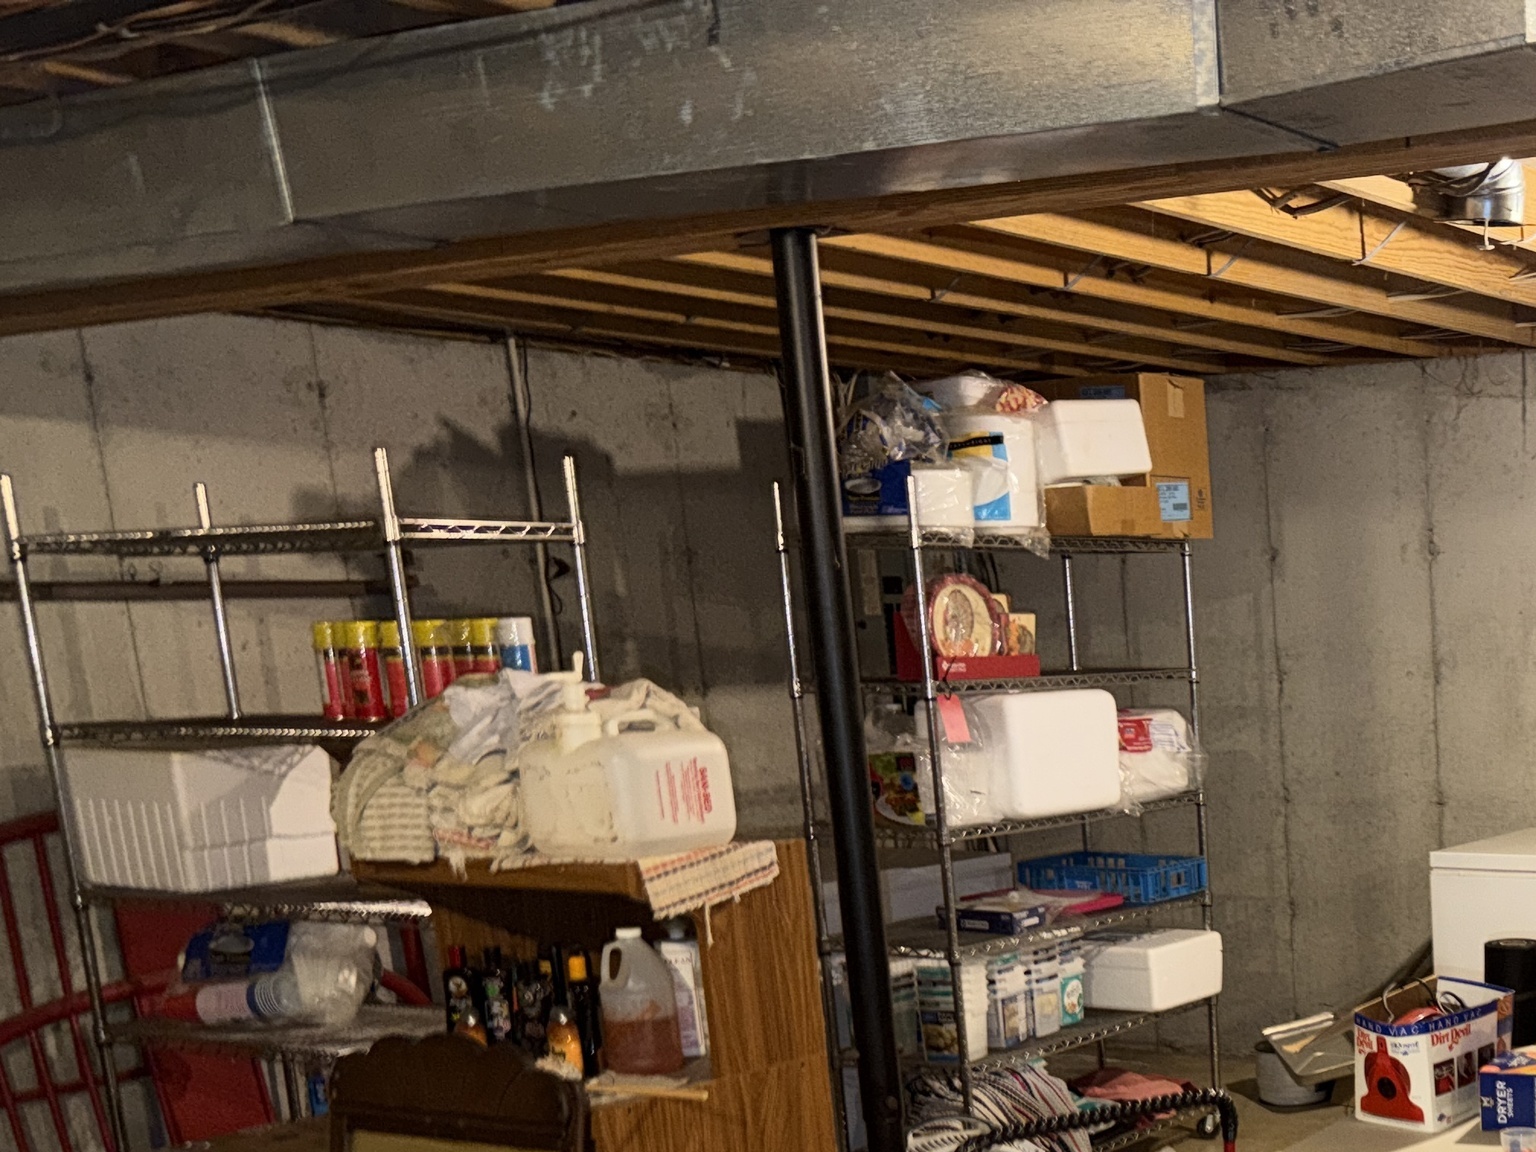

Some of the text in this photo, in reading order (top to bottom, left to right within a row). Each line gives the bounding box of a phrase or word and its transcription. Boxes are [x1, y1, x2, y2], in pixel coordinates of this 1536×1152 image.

[1355, 1017, 1419, 1036] HAND VAC
[1429, 1008, 1482, 1032] HAND VAC
[1430, 1023, 1472, 1047] Dirt Devil
[1495, 1079, 1508, 1125] DRYER
[1505, 1086, 1515, 1119] SHEETS
